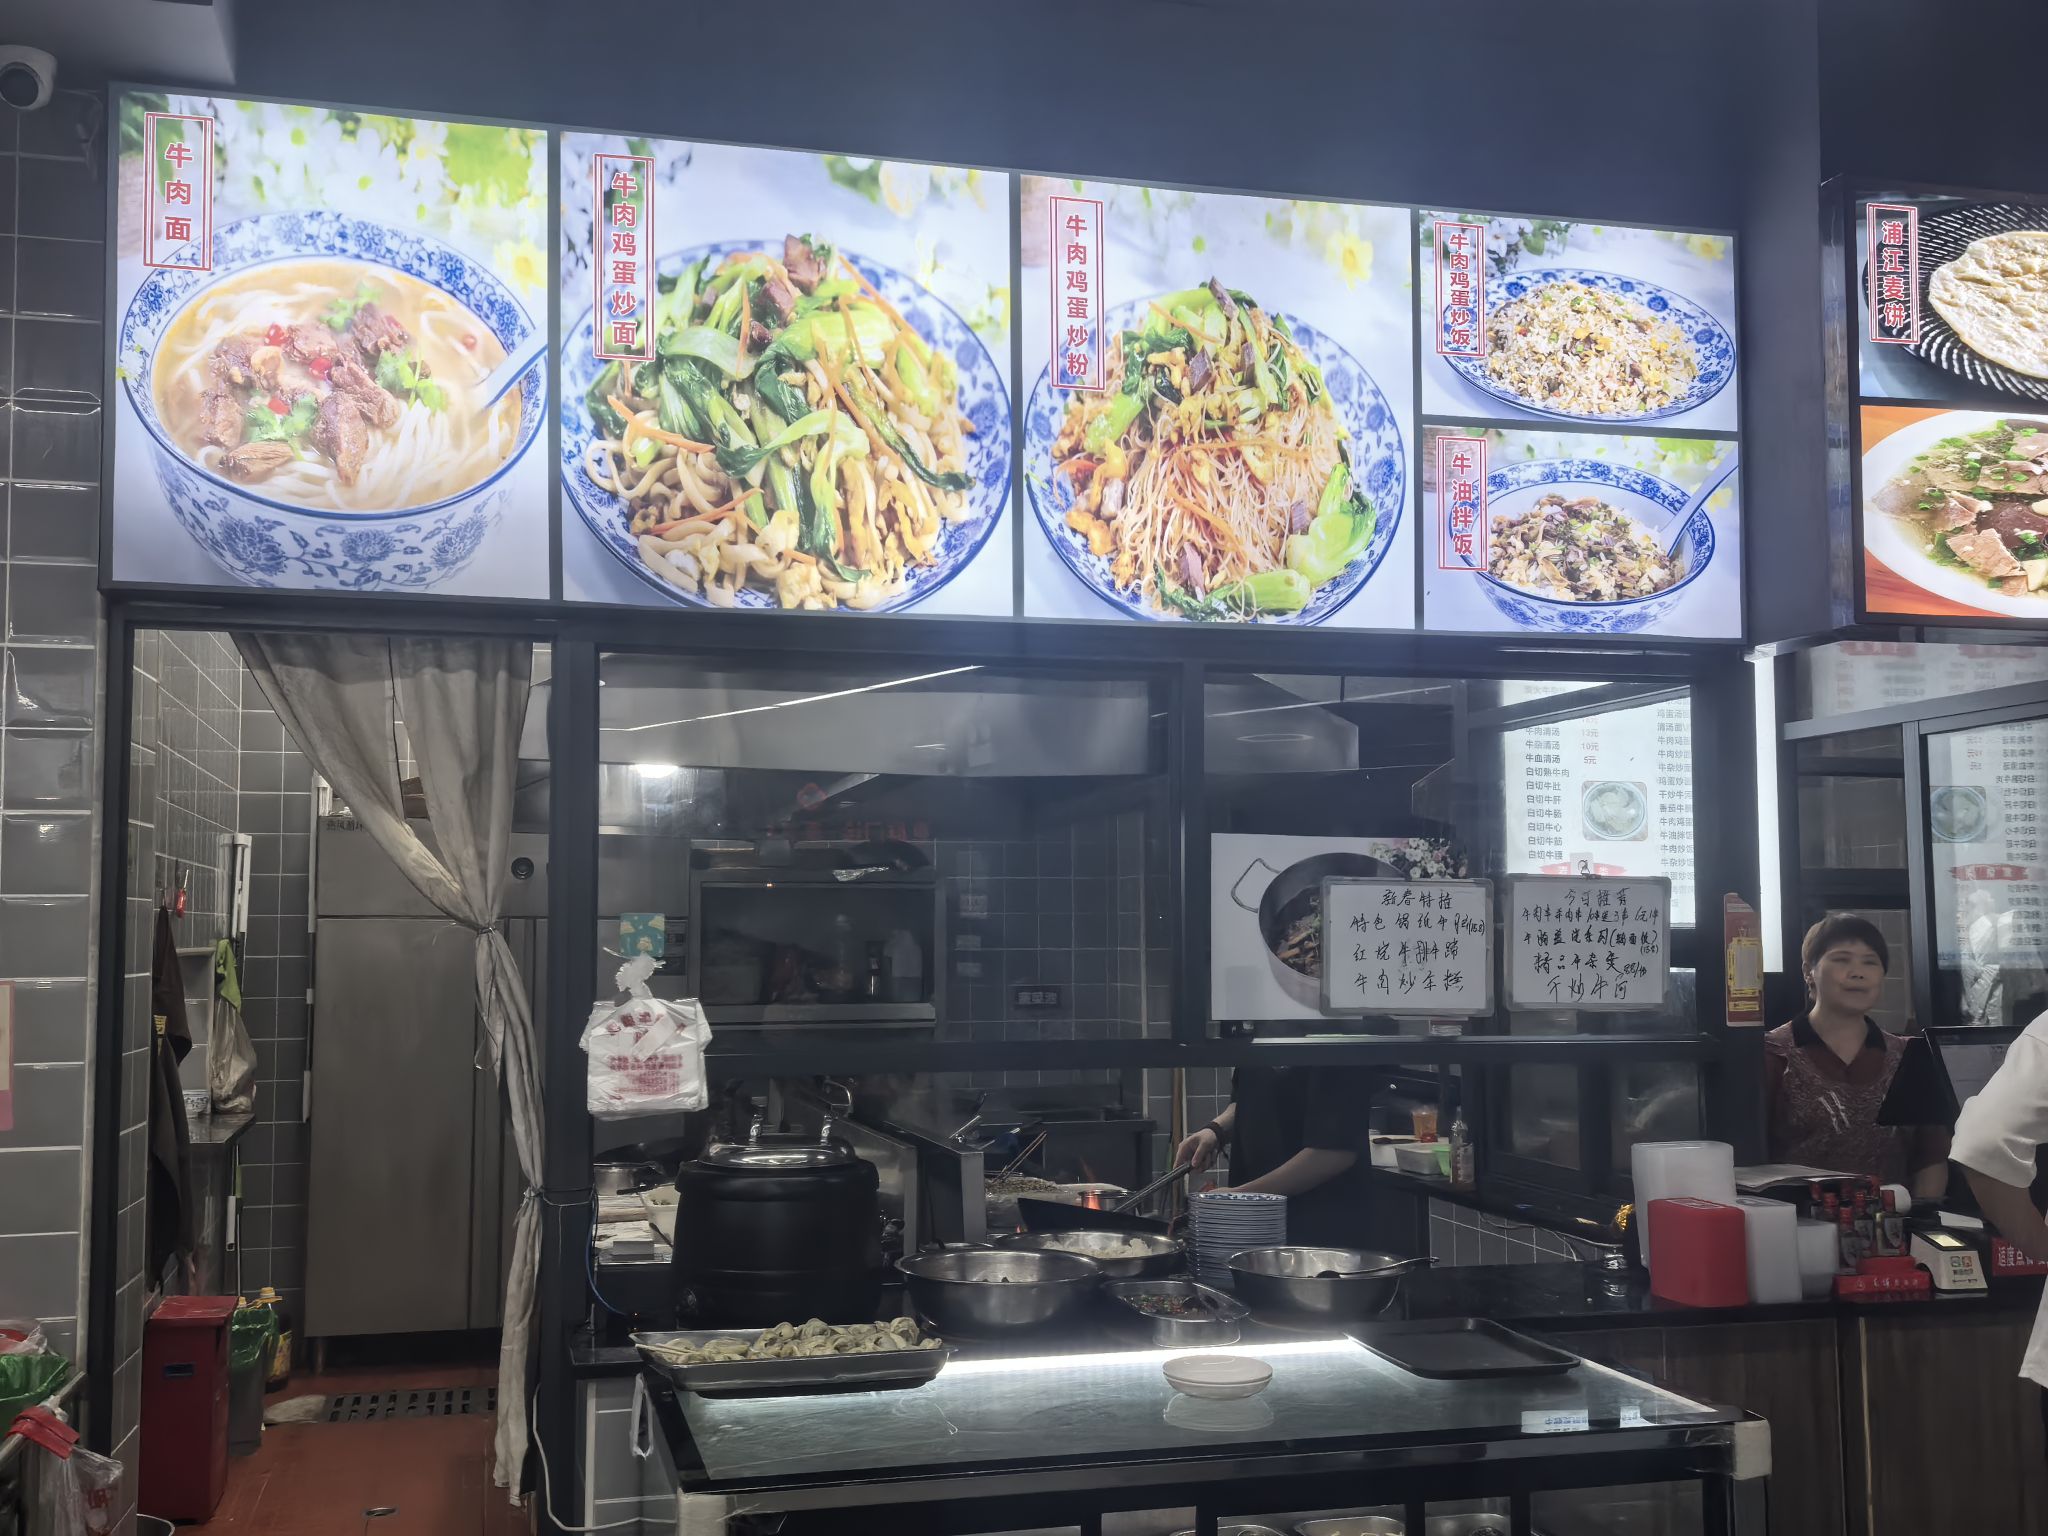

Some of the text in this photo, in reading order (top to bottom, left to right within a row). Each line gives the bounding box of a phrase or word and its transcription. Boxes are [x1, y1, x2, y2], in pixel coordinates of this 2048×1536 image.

[165, 143, 193, 241] 牛肉面
[612, 172, 637, 346] 牛肉鸡蛋炒面
[1066, 214, 1089, 376] 牛肉鸡蛋炒粉
[1449, 233, 1471, 346] 牛肉鸡蛋炒饭
[1882, 221, 1905, 328] 浦江麦饼
[1452, 453, 1473, 555] 牛油拌饭
[1525, 754, 1597, 765] 牛血清汤 5元
[1526, 781, 1561, 791] 白切牛肚
[1528, 822, 1562, 832] 白切牛心
[1381, 888, 1452, 909] 新春特推
